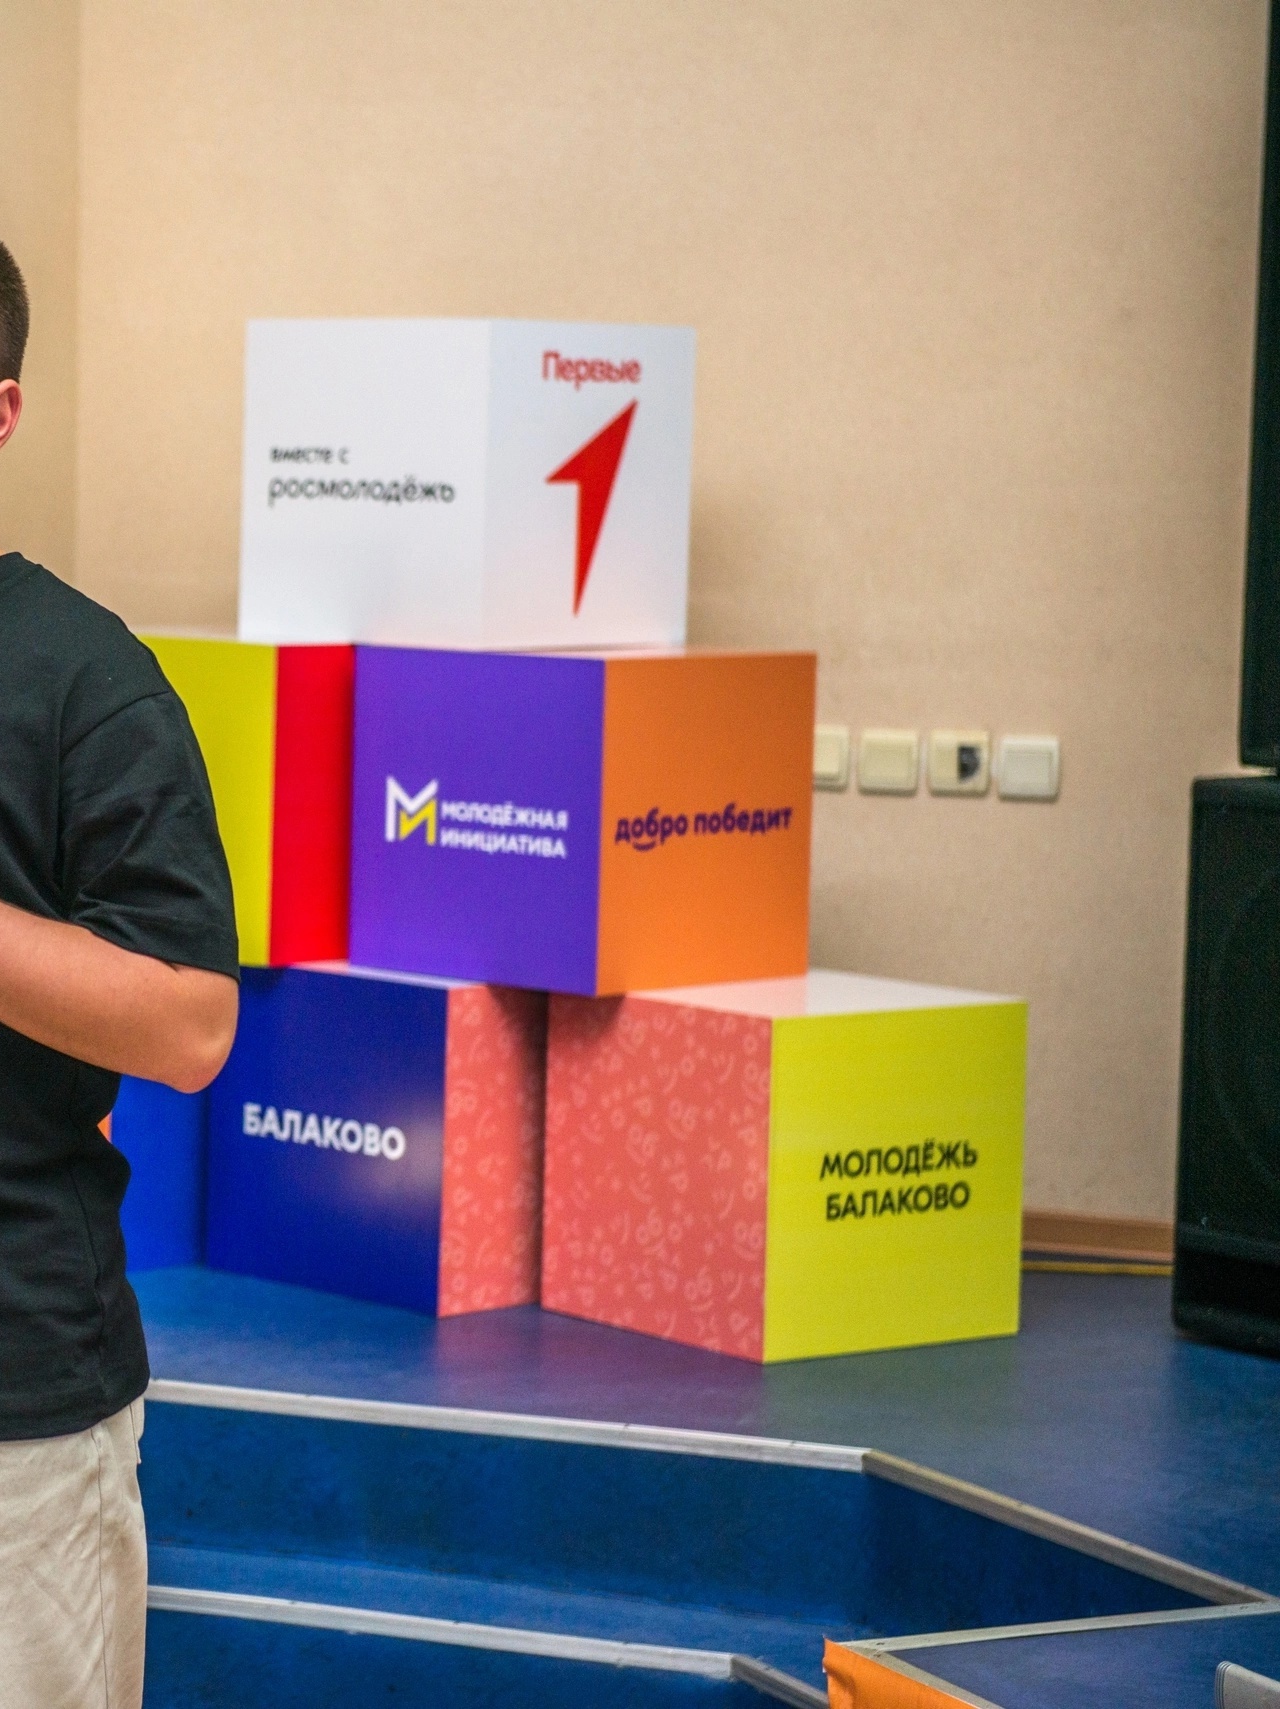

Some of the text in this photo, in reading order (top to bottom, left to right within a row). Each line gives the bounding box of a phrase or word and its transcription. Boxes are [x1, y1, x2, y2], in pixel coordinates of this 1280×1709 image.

[542, 350, 642, 390] Первые
[270, 446, 349, 465] вместе с
[269, 474, 455, 508] росмолодёжь
[441, 800, 568, 831] МОЛОДЁЖНАЯ
[615, 803, 793, 845] добро победит
[440, 827, 566, 859] ИНИЦИАТИВА
[242, 1102, 406, 1160] БАЛАКОВО
[819, 1138, 978, 1180] МОЛОДЁЖЬ
[826, 1181, 971, 1222] БАЛАКОВО
